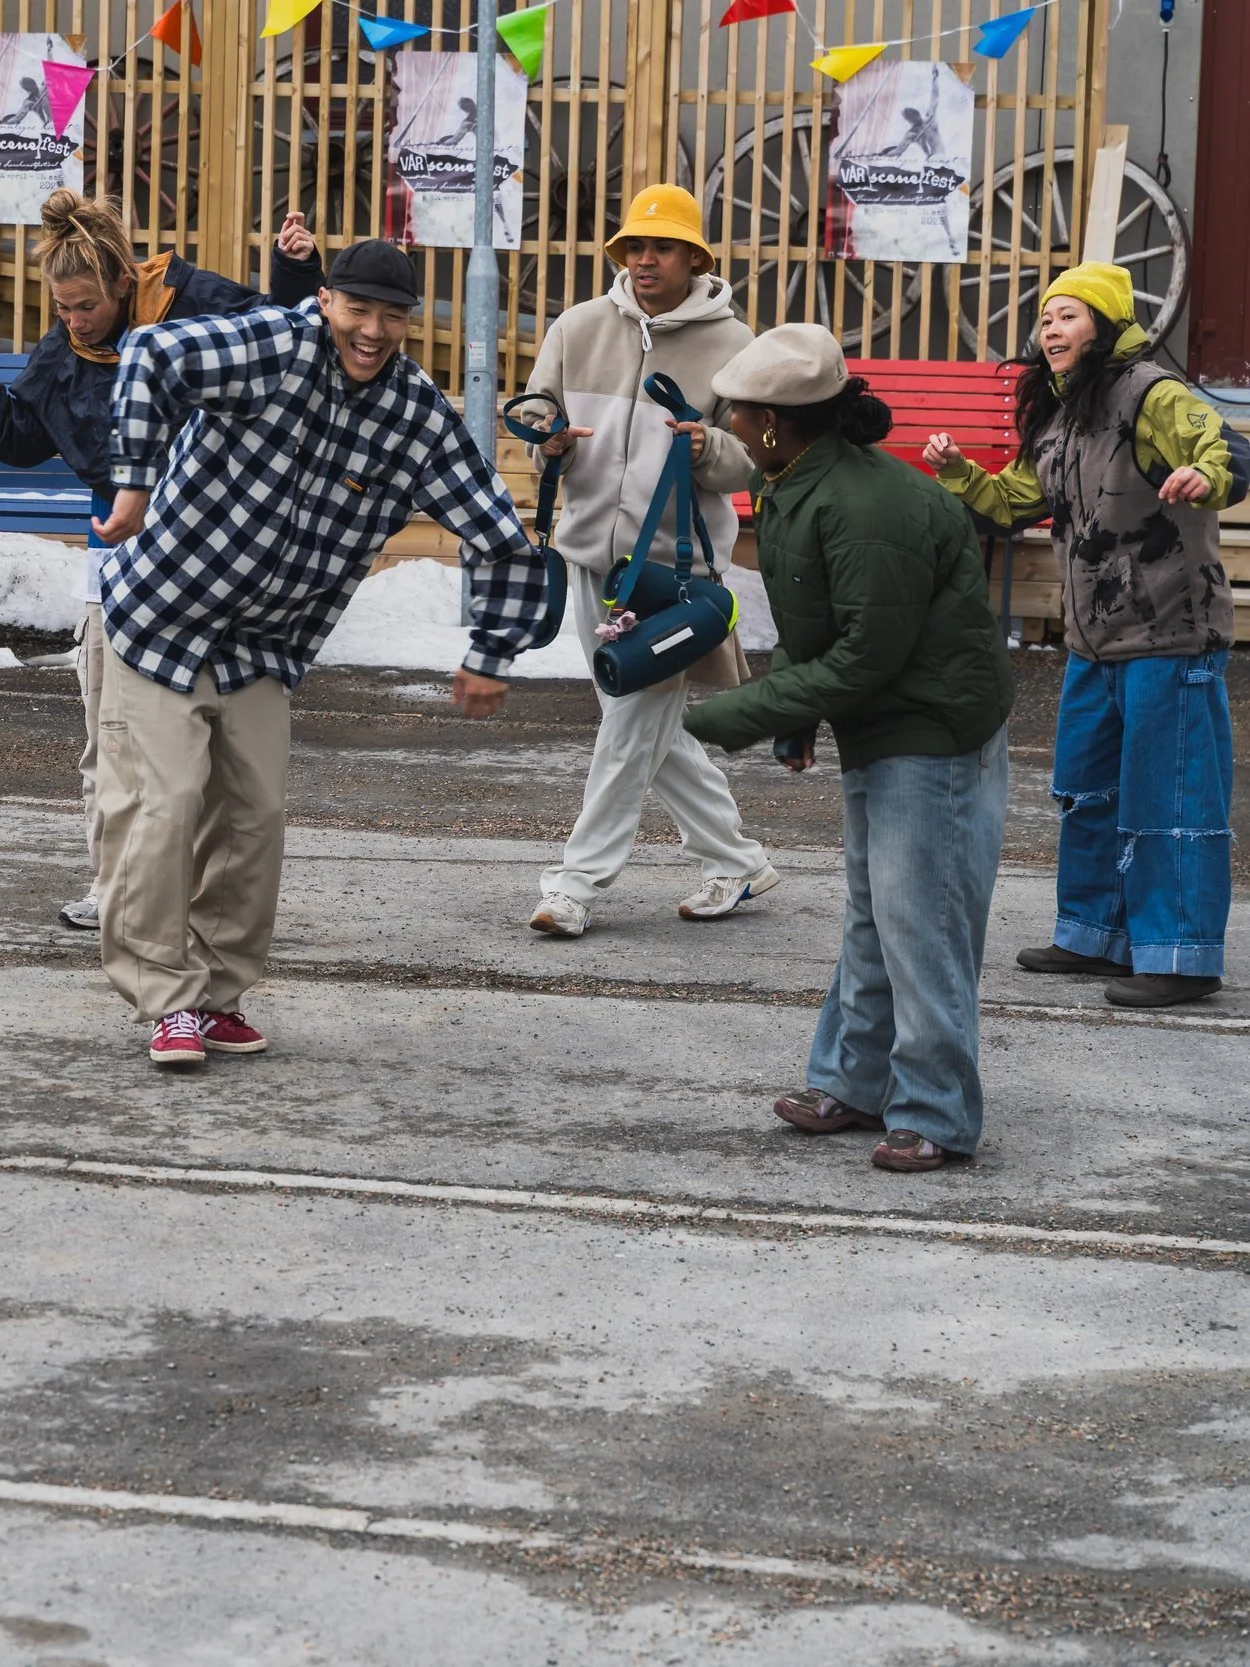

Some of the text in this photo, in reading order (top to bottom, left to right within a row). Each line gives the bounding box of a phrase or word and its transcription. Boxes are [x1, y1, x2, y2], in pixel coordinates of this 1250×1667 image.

[41, 136, 70, 157] fest
[493, 164, 510, 179] st
[923, 168, 956, 191] fest
